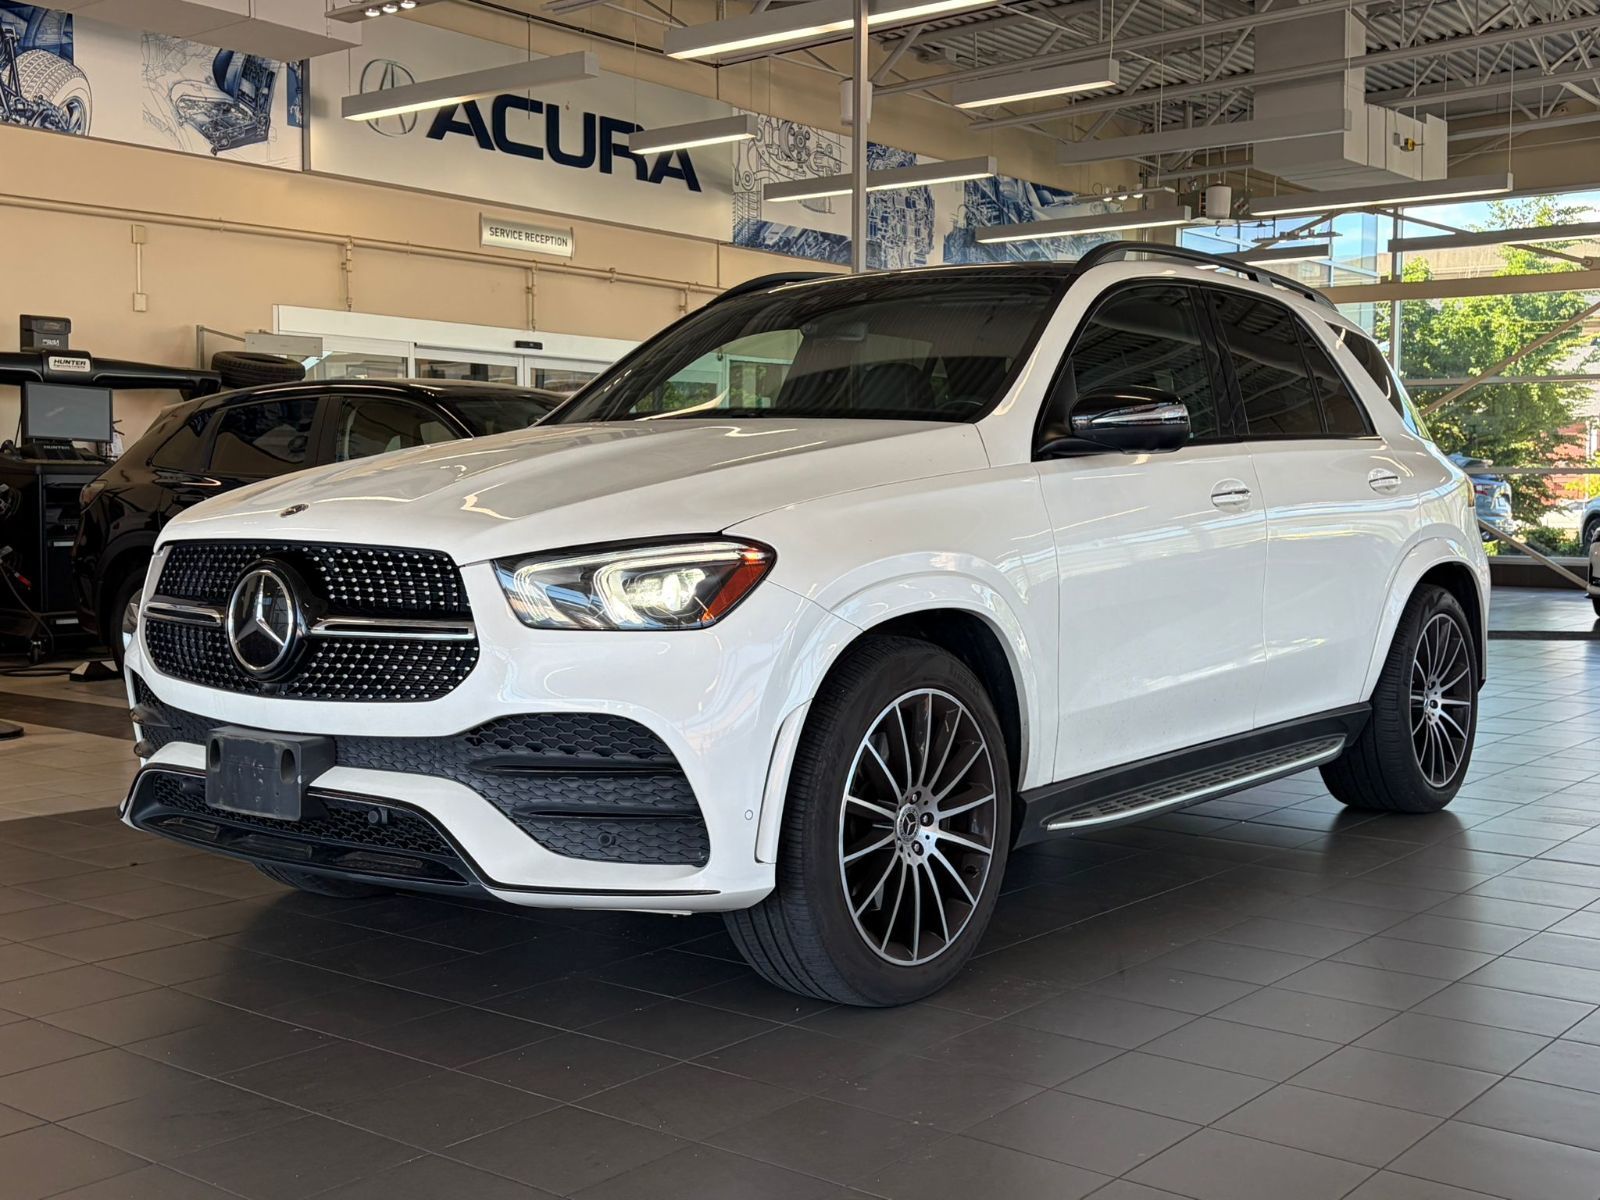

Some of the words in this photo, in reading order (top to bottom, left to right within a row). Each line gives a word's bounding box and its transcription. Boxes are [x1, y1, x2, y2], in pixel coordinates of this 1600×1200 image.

[426, 94, 702, 192] ACURA
[489, 226, 523, 241] SERVICE
[525, 232, 568, 247] RECEPTION
